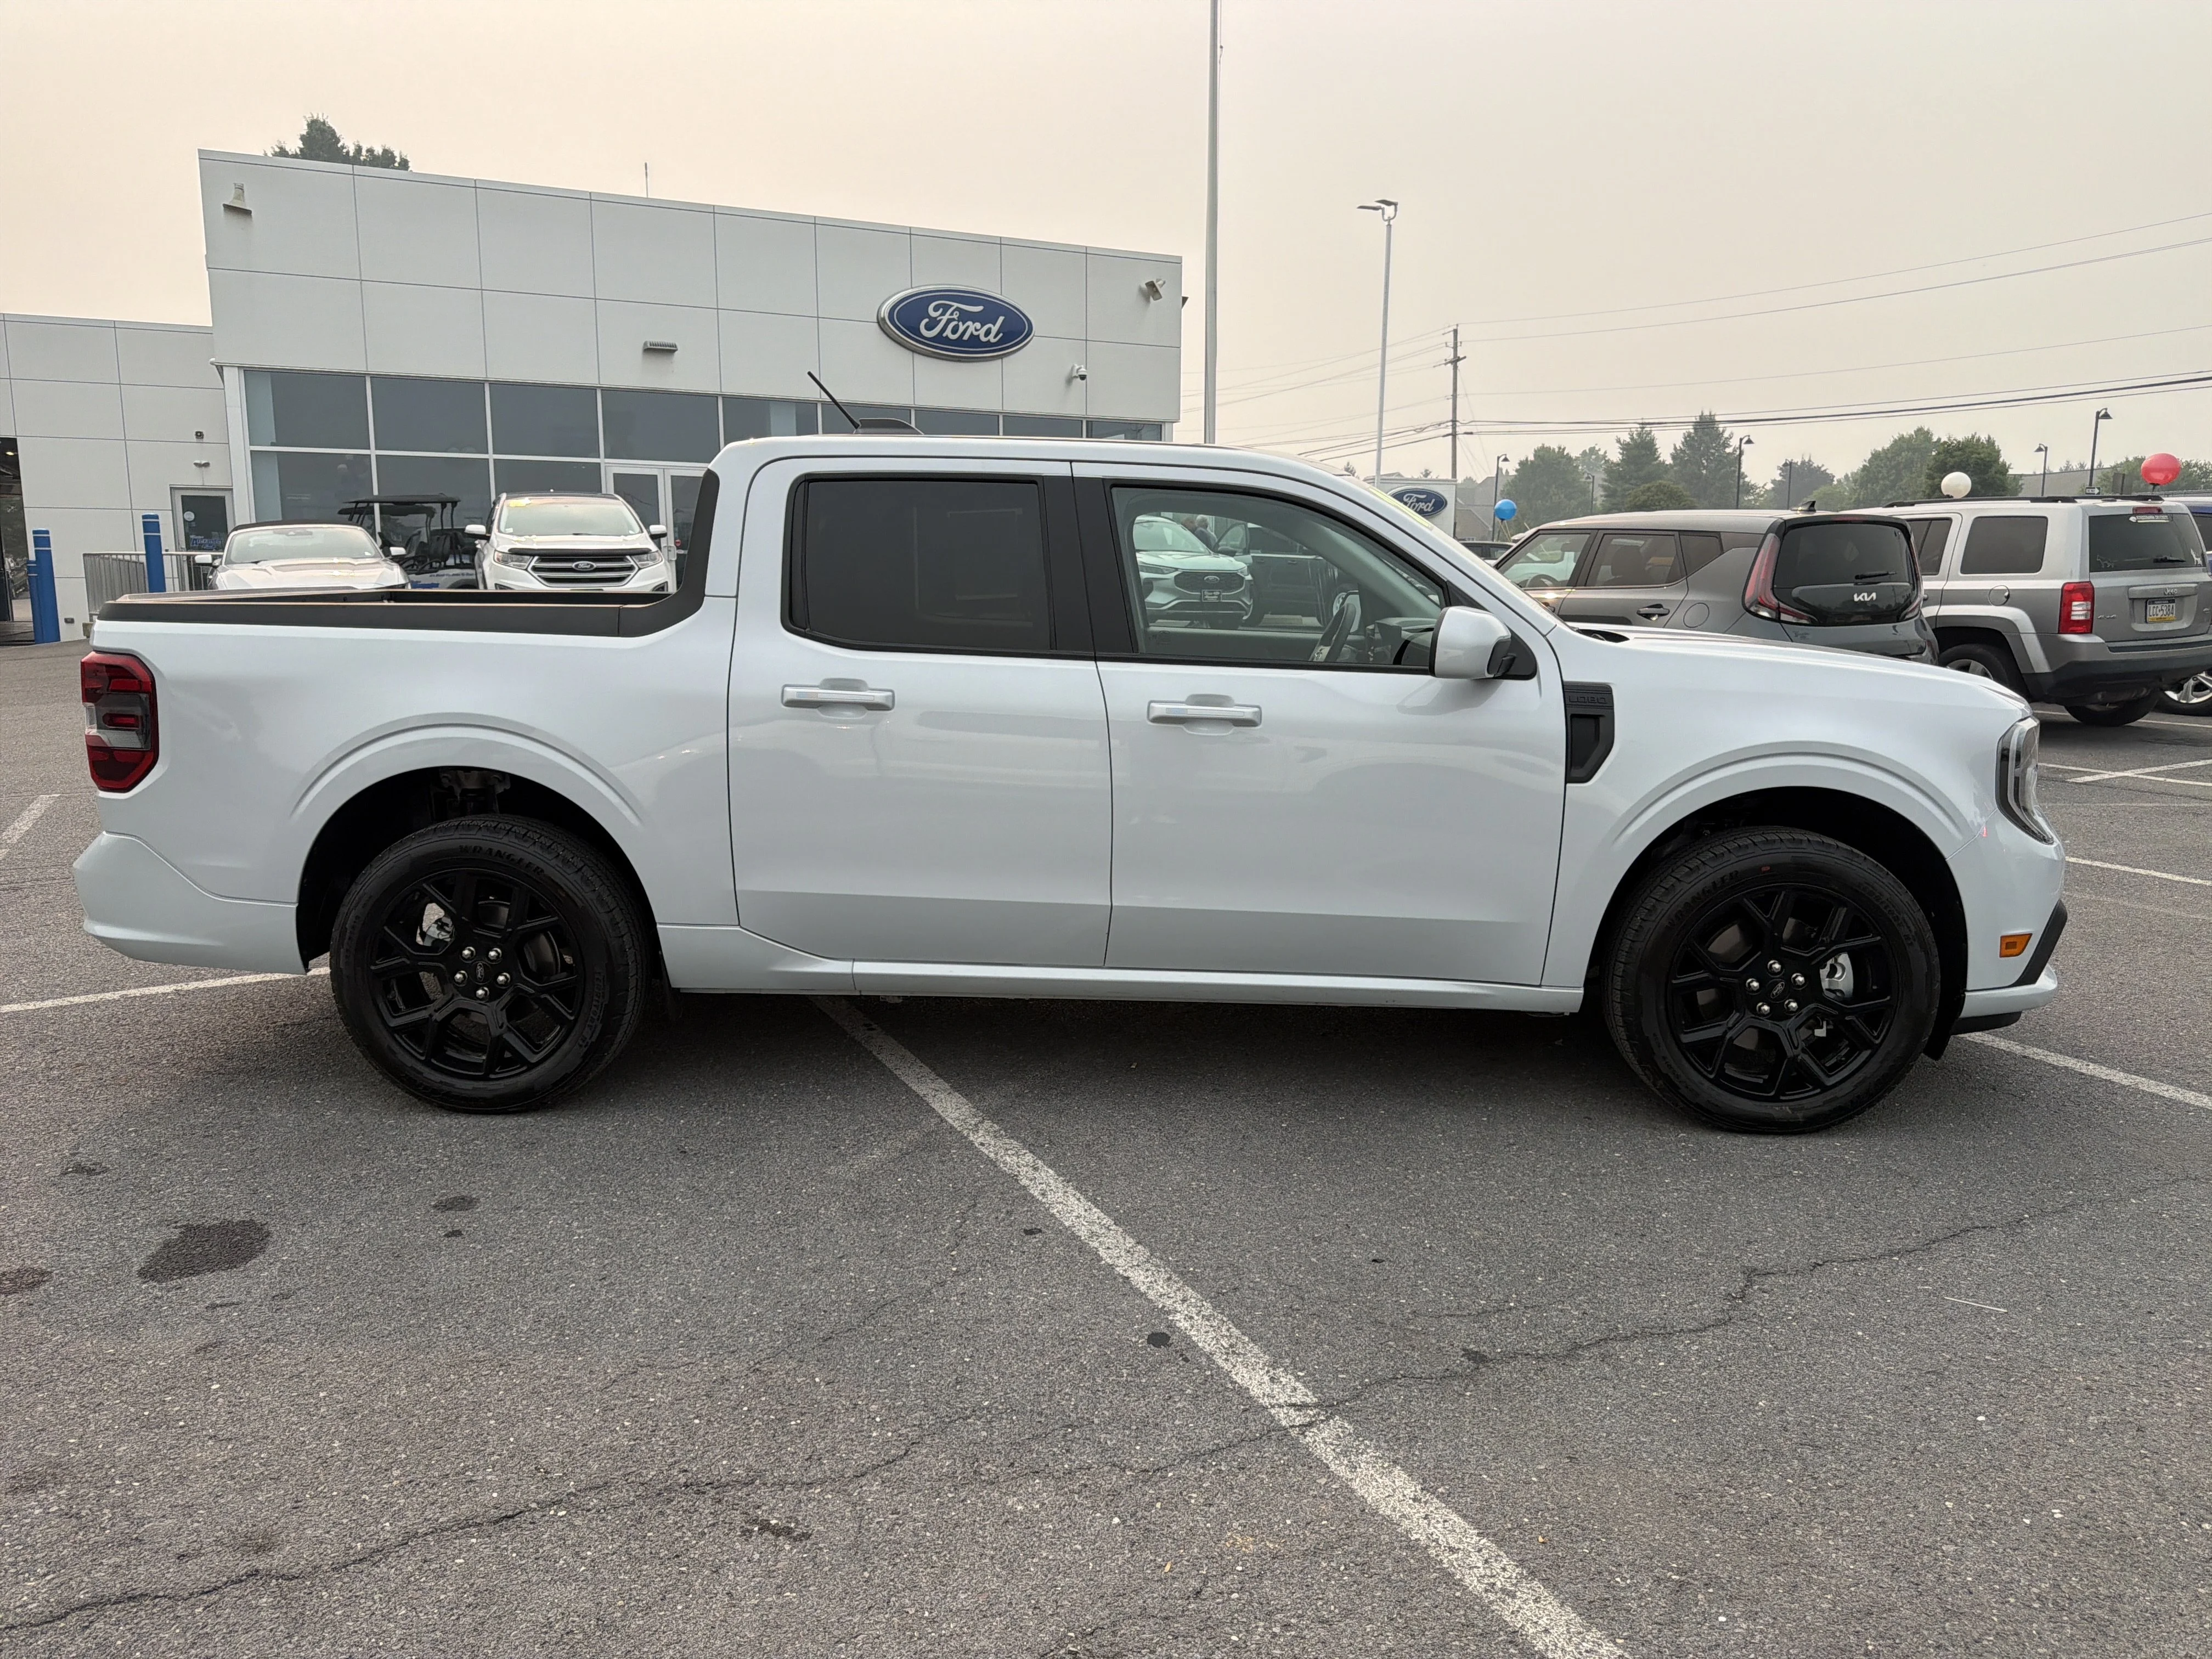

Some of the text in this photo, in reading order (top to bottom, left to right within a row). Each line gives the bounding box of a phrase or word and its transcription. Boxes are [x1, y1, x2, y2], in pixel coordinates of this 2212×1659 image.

[919, 300, 1006, 343] Ford
[1402, 493, 1435, 512] Ford
[1853, 592, 1876, 602] KIA
[1568, 695, 1607, 704] LOBO
[459, 844, 545, 876] WRANGLER
